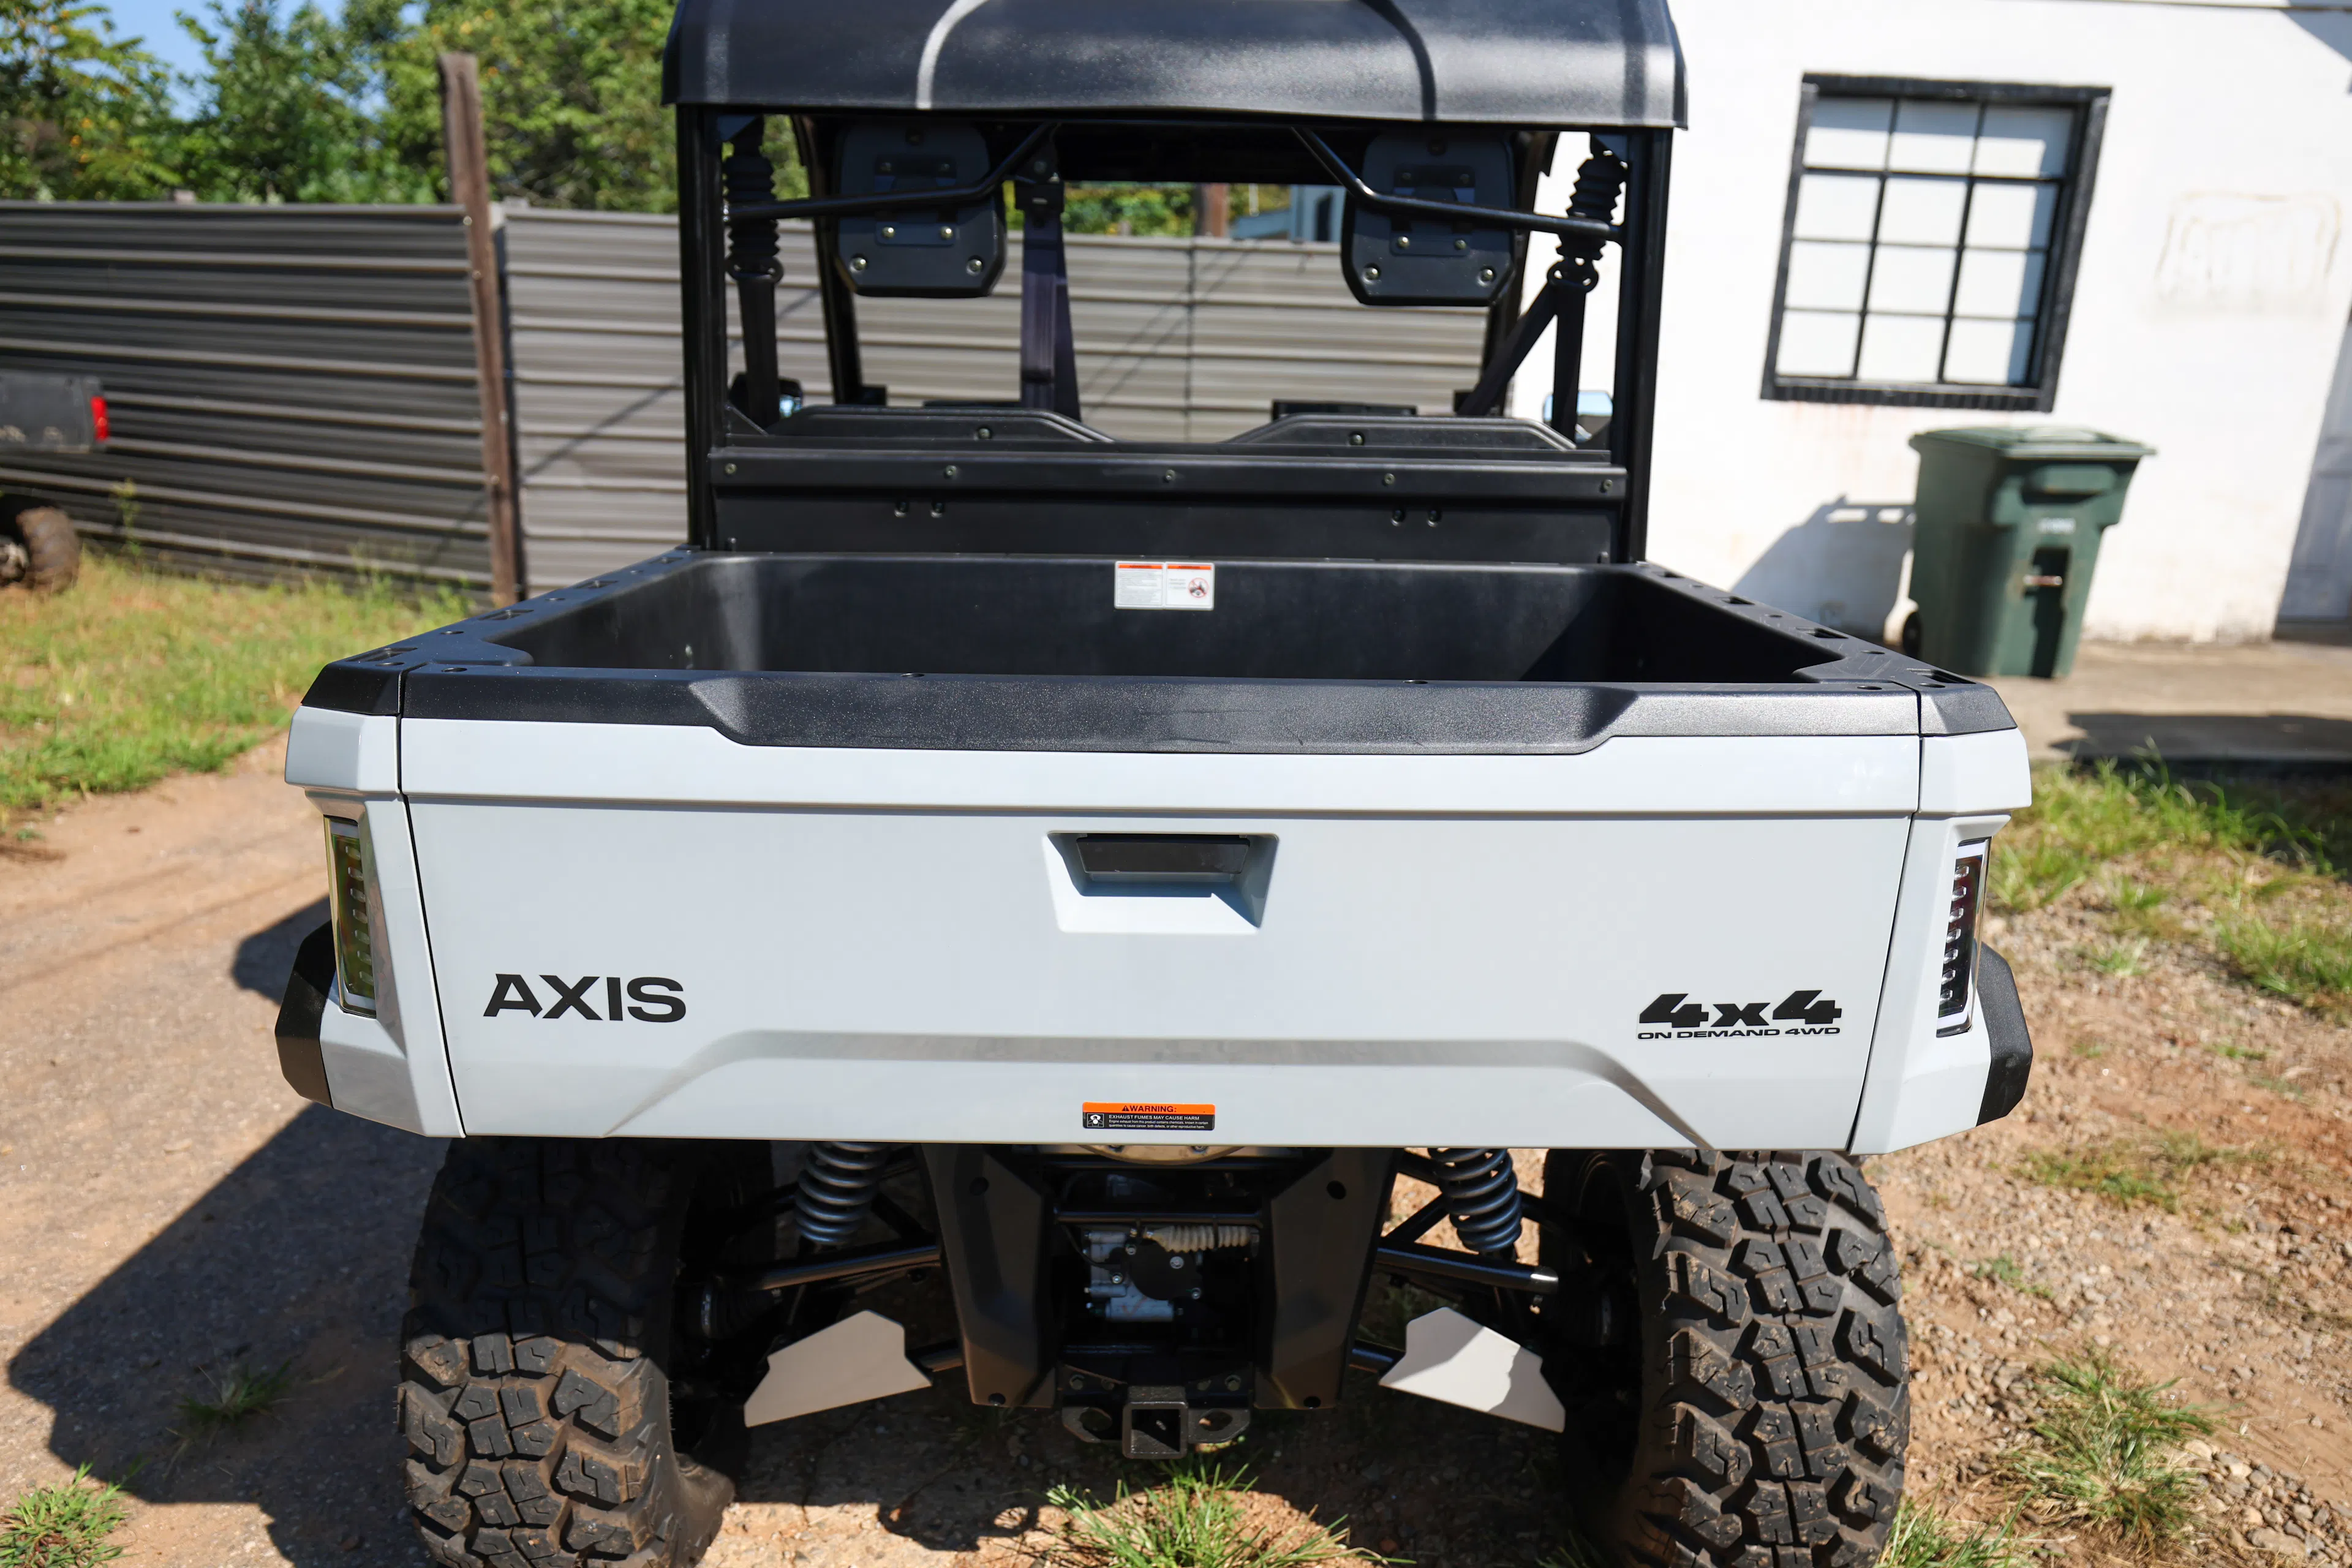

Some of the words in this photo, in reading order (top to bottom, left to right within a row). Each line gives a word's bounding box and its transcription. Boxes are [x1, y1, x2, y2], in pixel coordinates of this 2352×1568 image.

[483, 973, 686, 1023] AXIS
[1639, 989, 1842, 1028] 4x4
[1637, 1031, 1672, 1040] ON
[1676, 1029, 1780, 1038] DEMAND
[1785, 1027, 1841, 1036] 4WD
